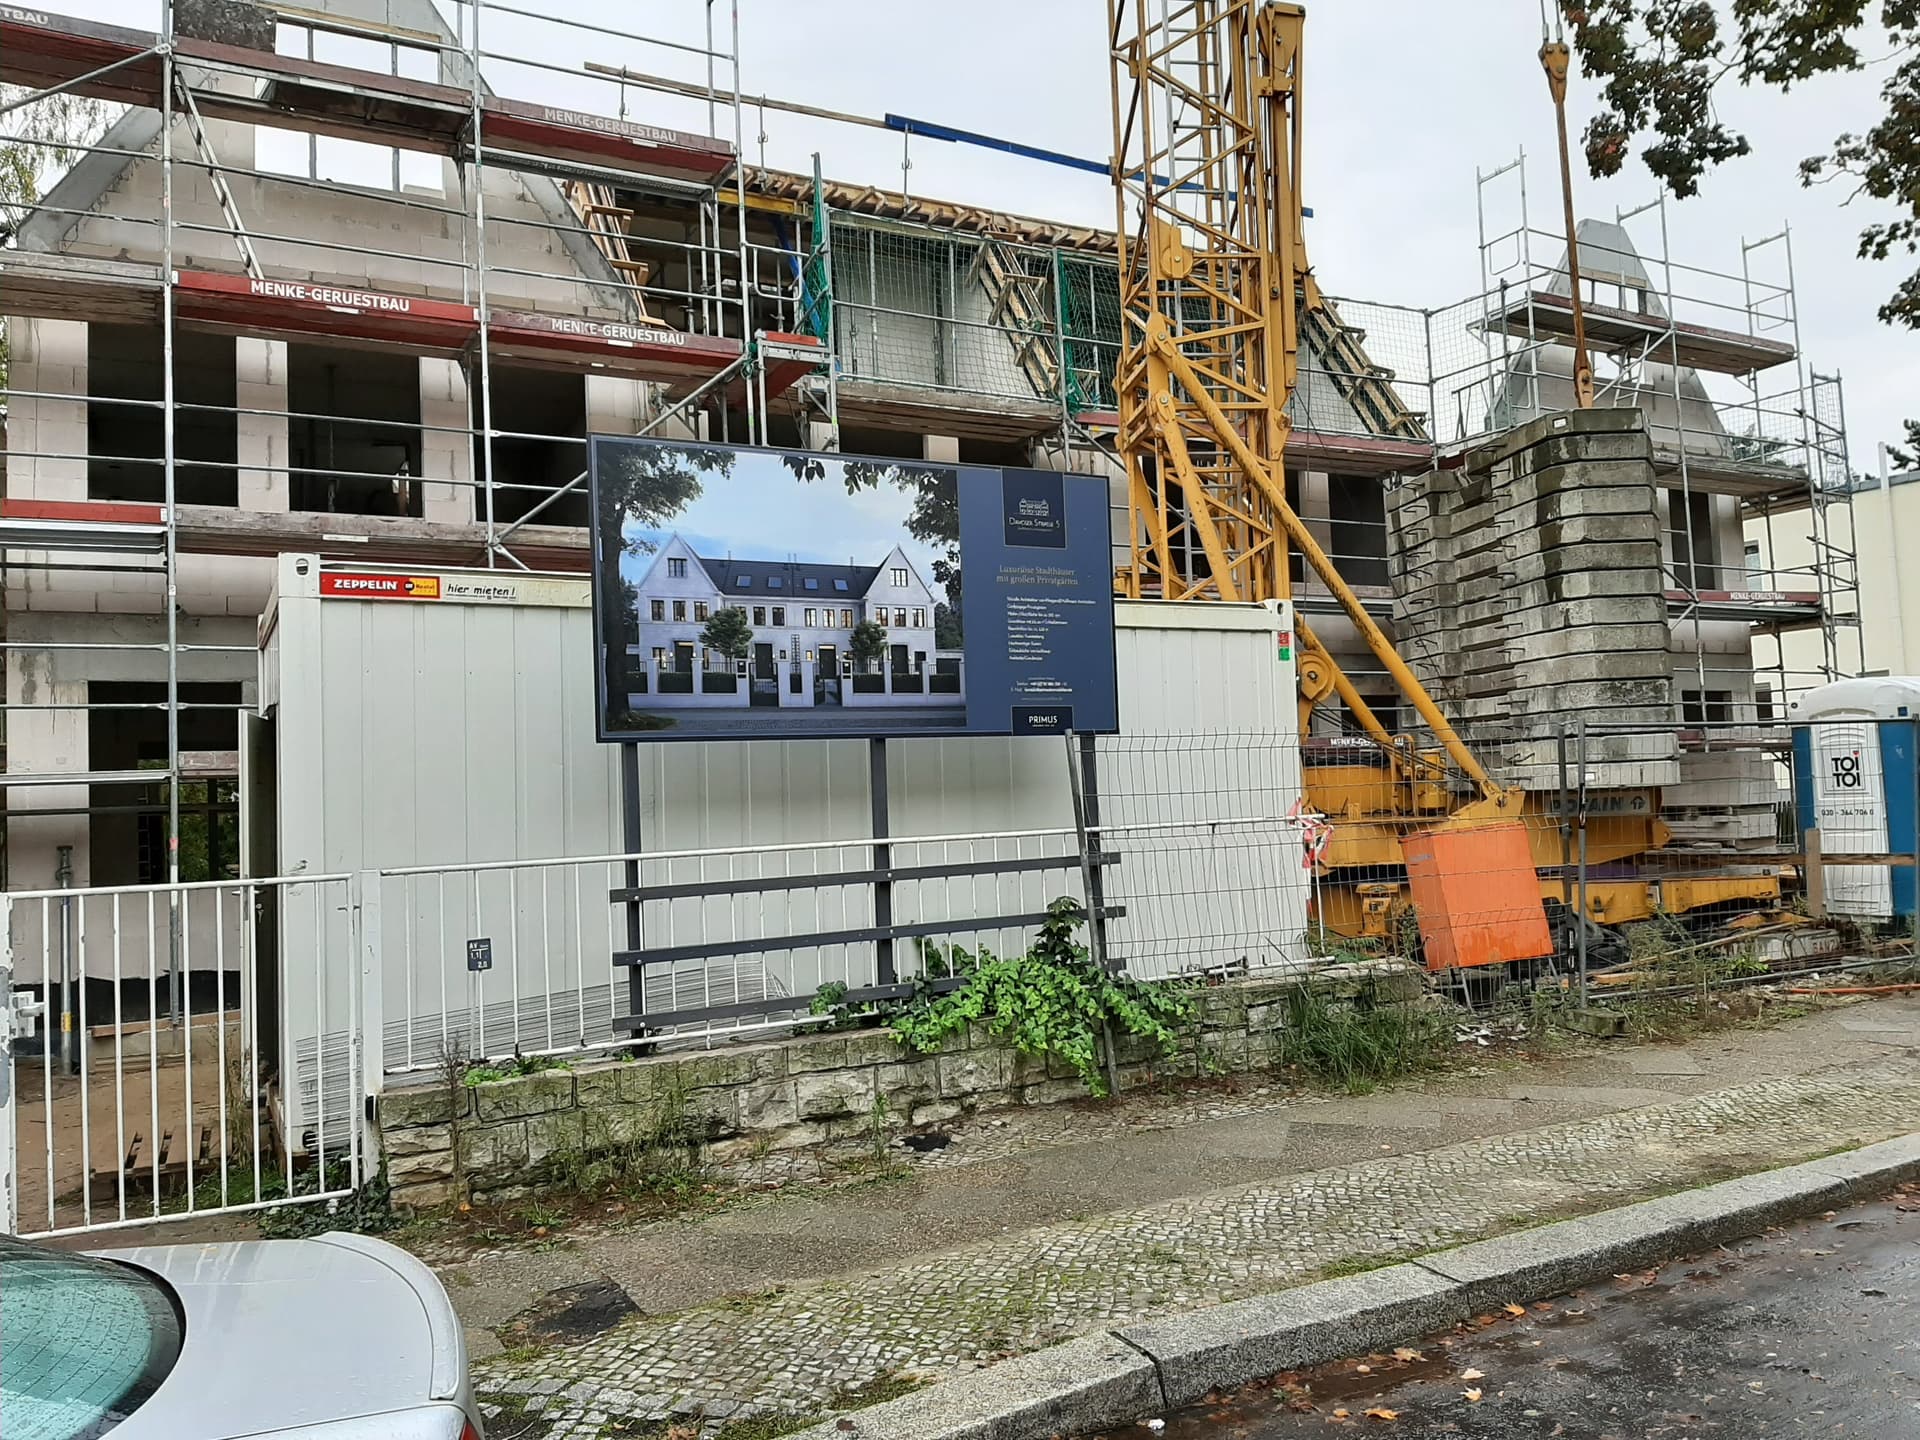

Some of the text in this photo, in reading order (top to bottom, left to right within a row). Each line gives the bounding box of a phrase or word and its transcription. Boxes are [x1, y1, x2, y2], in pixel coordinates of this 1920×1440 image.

[0, 7, 49, 25] TBAU
[544, 107, 677, 143] MENKE-GERUESTBAU
[250, 279, 410, 312] MENKE-GERUESTBAU
[551, 318, 686, 346] MENKE-GERUESTBAU
[333, 578, 399, 590] ZEPPELIN
[447, 583, 469, 594] hier
[1028, 715, 1058, 724] PRIMUS
[1832, 772, 1861, 788] TOI
